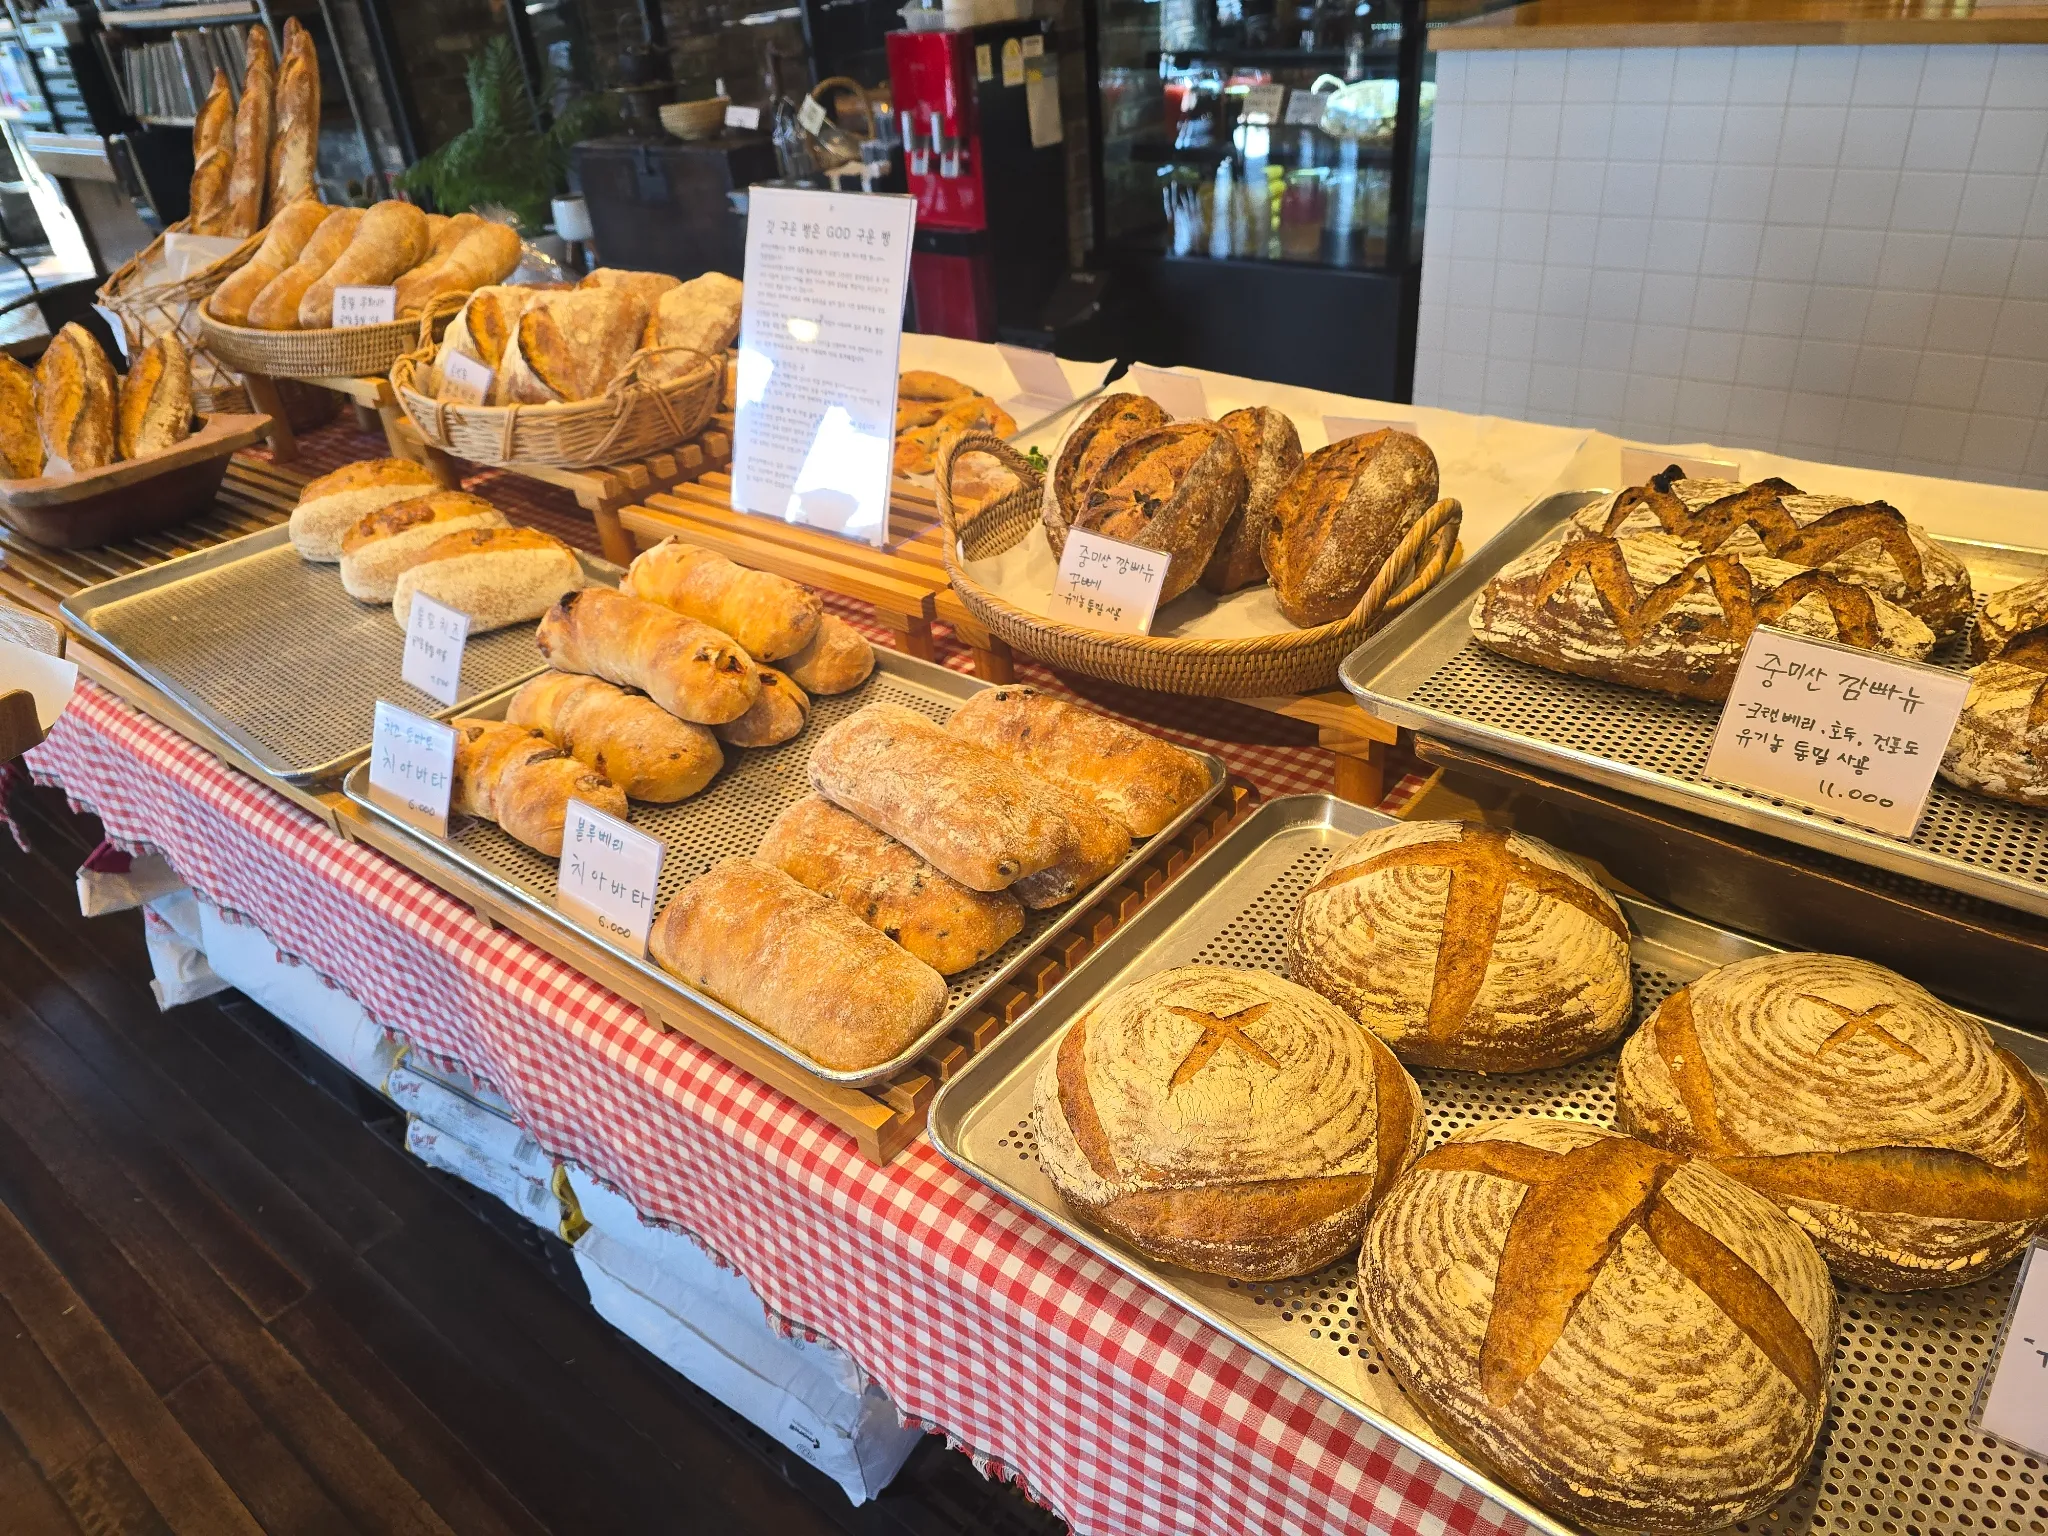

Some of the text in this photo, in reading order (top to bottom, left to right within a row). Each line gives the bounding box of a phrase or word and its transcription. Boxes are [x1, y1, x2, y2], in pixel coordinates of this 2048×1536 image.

[780, 220, 797, 237] 구운
[826, 225, 851, 240] GOD
[856, 228, 876, 245] 구운
[1078, 544, 1112, 568] 중미산
[1105, 607, 1122, 621] 사용
[1755, 653, 1925, 714] 중미산 깜빠뉴
[1736, 728, 1870, 776] 유기농 통밀 사용
[1872, 734, 1920, 755] 건포도
[382, 748, 448, 790] 치아바타
[408, 799, 436, 817] 6.000
[575, 817, 625, 854] 블루베리
[571, 853, 650, 909] 치아바타
[598, 915, 631, 938] 6.000
